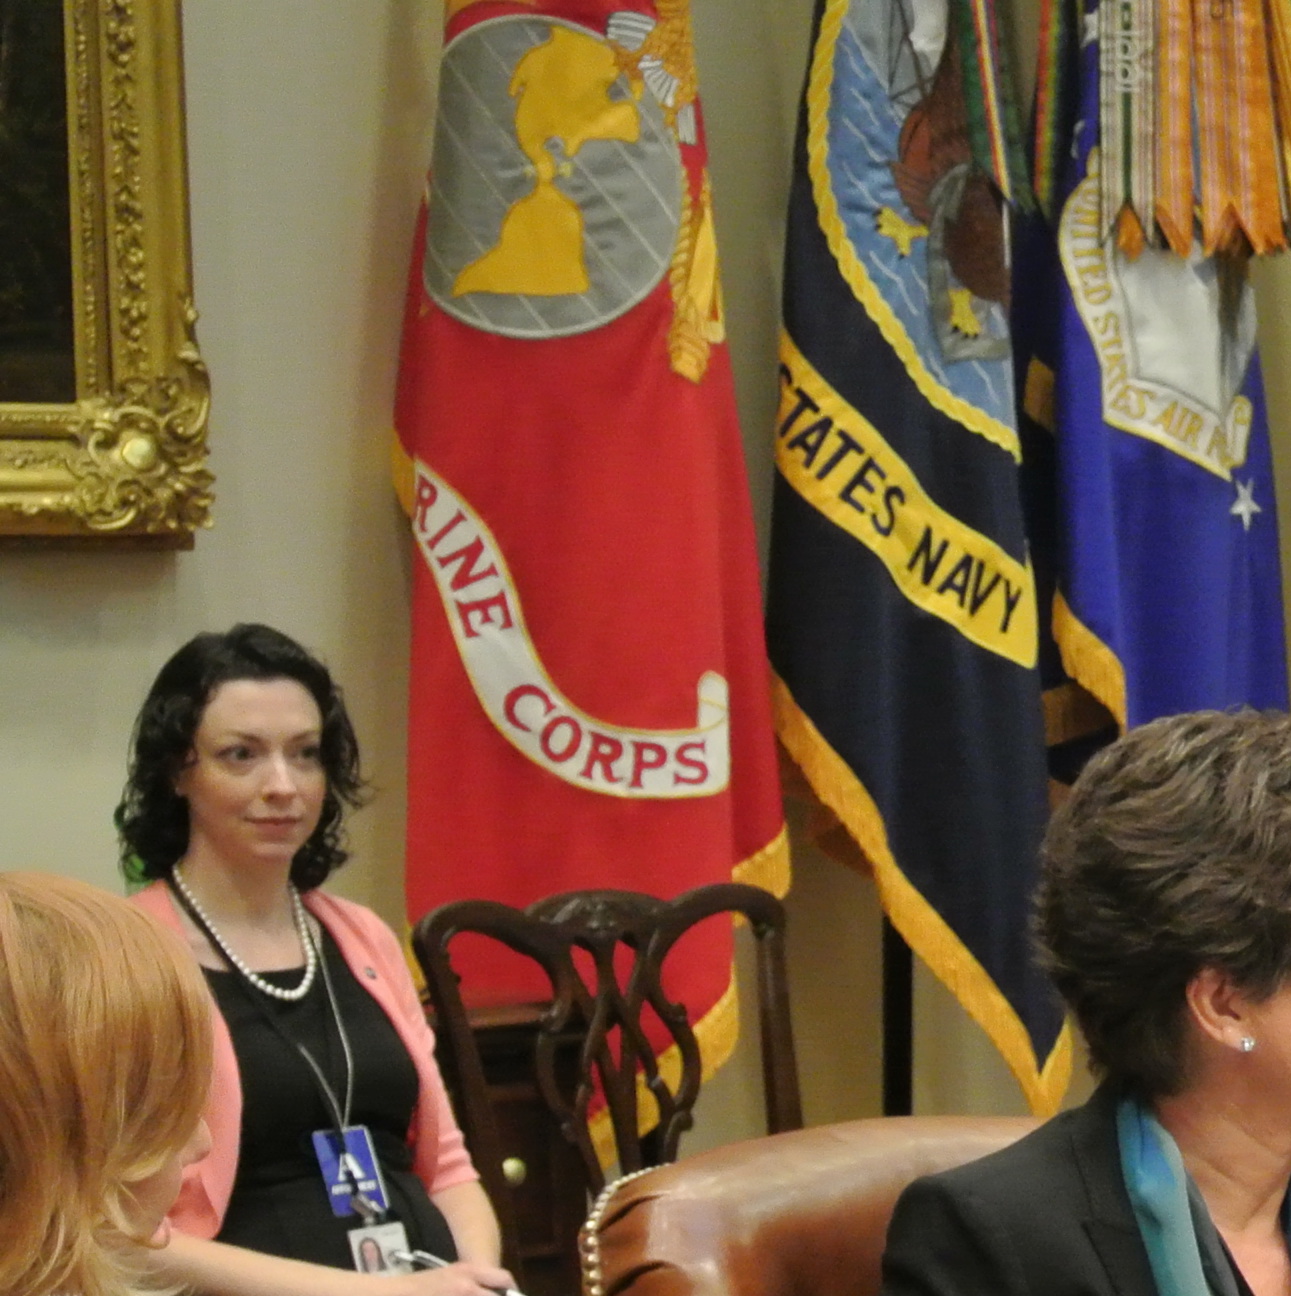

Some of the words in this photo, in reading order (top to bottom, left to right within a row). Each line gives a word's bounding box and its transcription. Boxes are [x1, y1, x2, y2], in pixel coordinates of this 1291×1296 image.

[1155, 402, 1203, 448] AIR
[906, 525, 1022, 634] NAVY
[503, 684, 710, 788] CORPS
